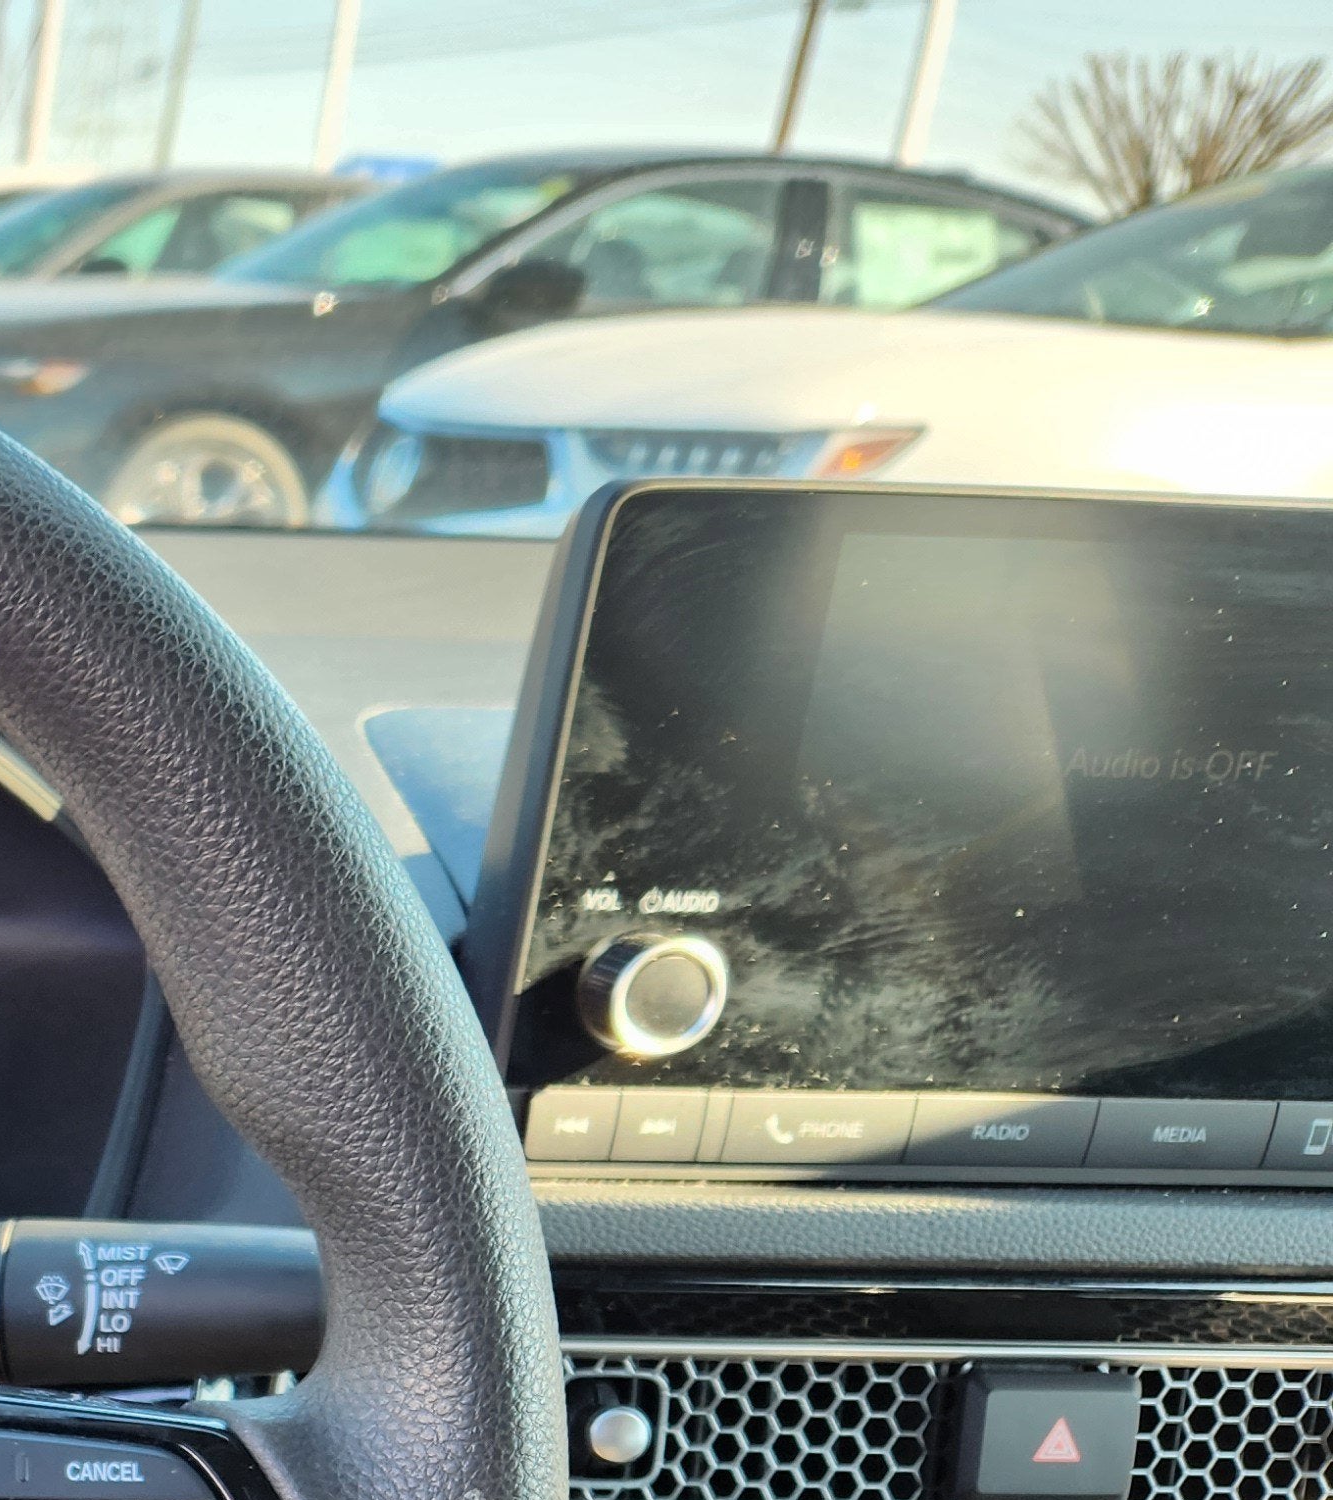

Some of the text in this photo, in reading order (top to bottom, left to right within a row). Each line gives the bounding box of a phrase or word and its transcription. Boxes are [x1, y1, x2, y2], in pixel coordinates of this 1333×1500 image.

[1065, 744, 1280, 782] Audio is OFF
[583, 889, 623, 911] VOL
[663, 889, 720, 912] AUDIO
[799, 1120, 864, 1139] PHONE
[971, 1123, 1030, 1141] RADIO
[1153, 1125, 1207, 1143] MEDIA
[97, 1243, 151, 1262] MIST
[100, 1268, 146, 1287] OFF
[101, 1290, 142, 1309] INT
[99, 1314, 131, 1333] LO
[96, 1336, 121, 1354] HI
[66, 1461, 145, 1483] CANCEL
